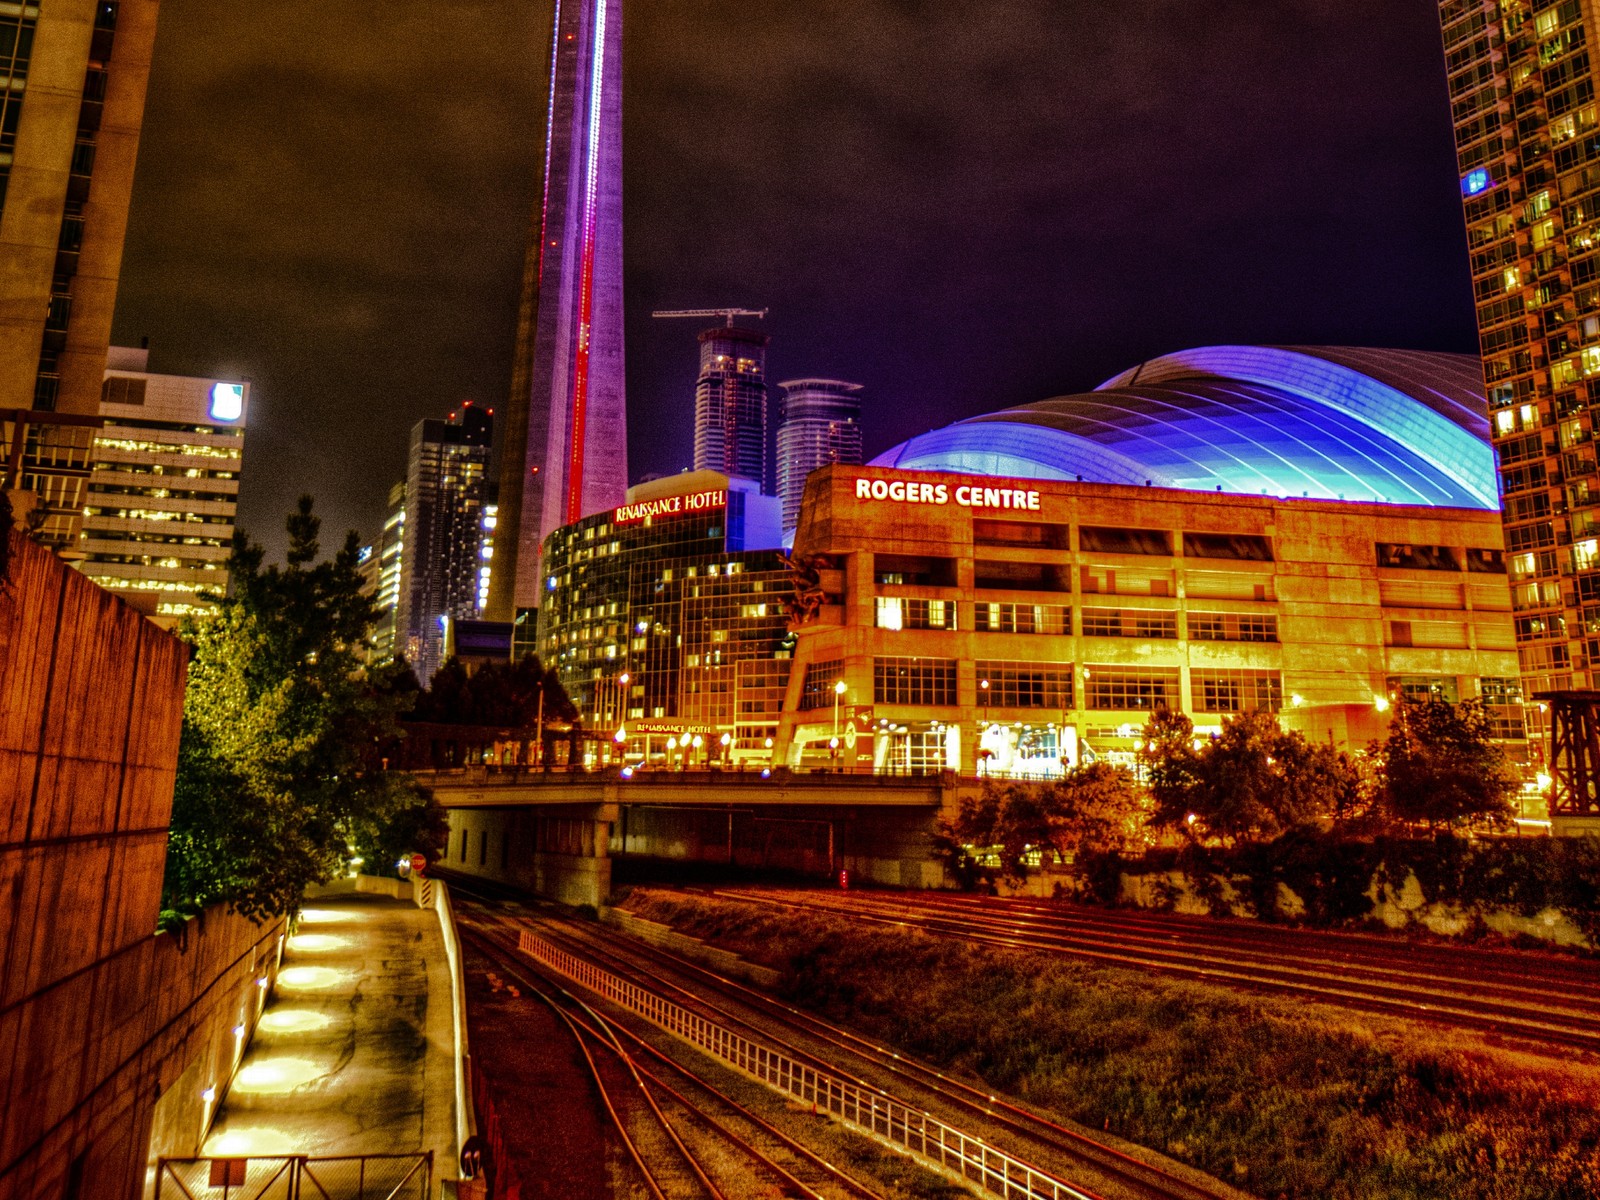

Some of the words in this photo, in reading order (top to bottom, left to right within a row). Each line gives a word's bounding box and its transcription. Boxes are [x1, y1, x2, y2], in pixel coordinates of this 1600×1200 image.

[616, 496, 680, 522] RENAISSANCE
[685, 490, 725, 510] HOTEL
[856, 478, 948, 504] ROGERS
[955, 486, 1040, 510] CENTRE
